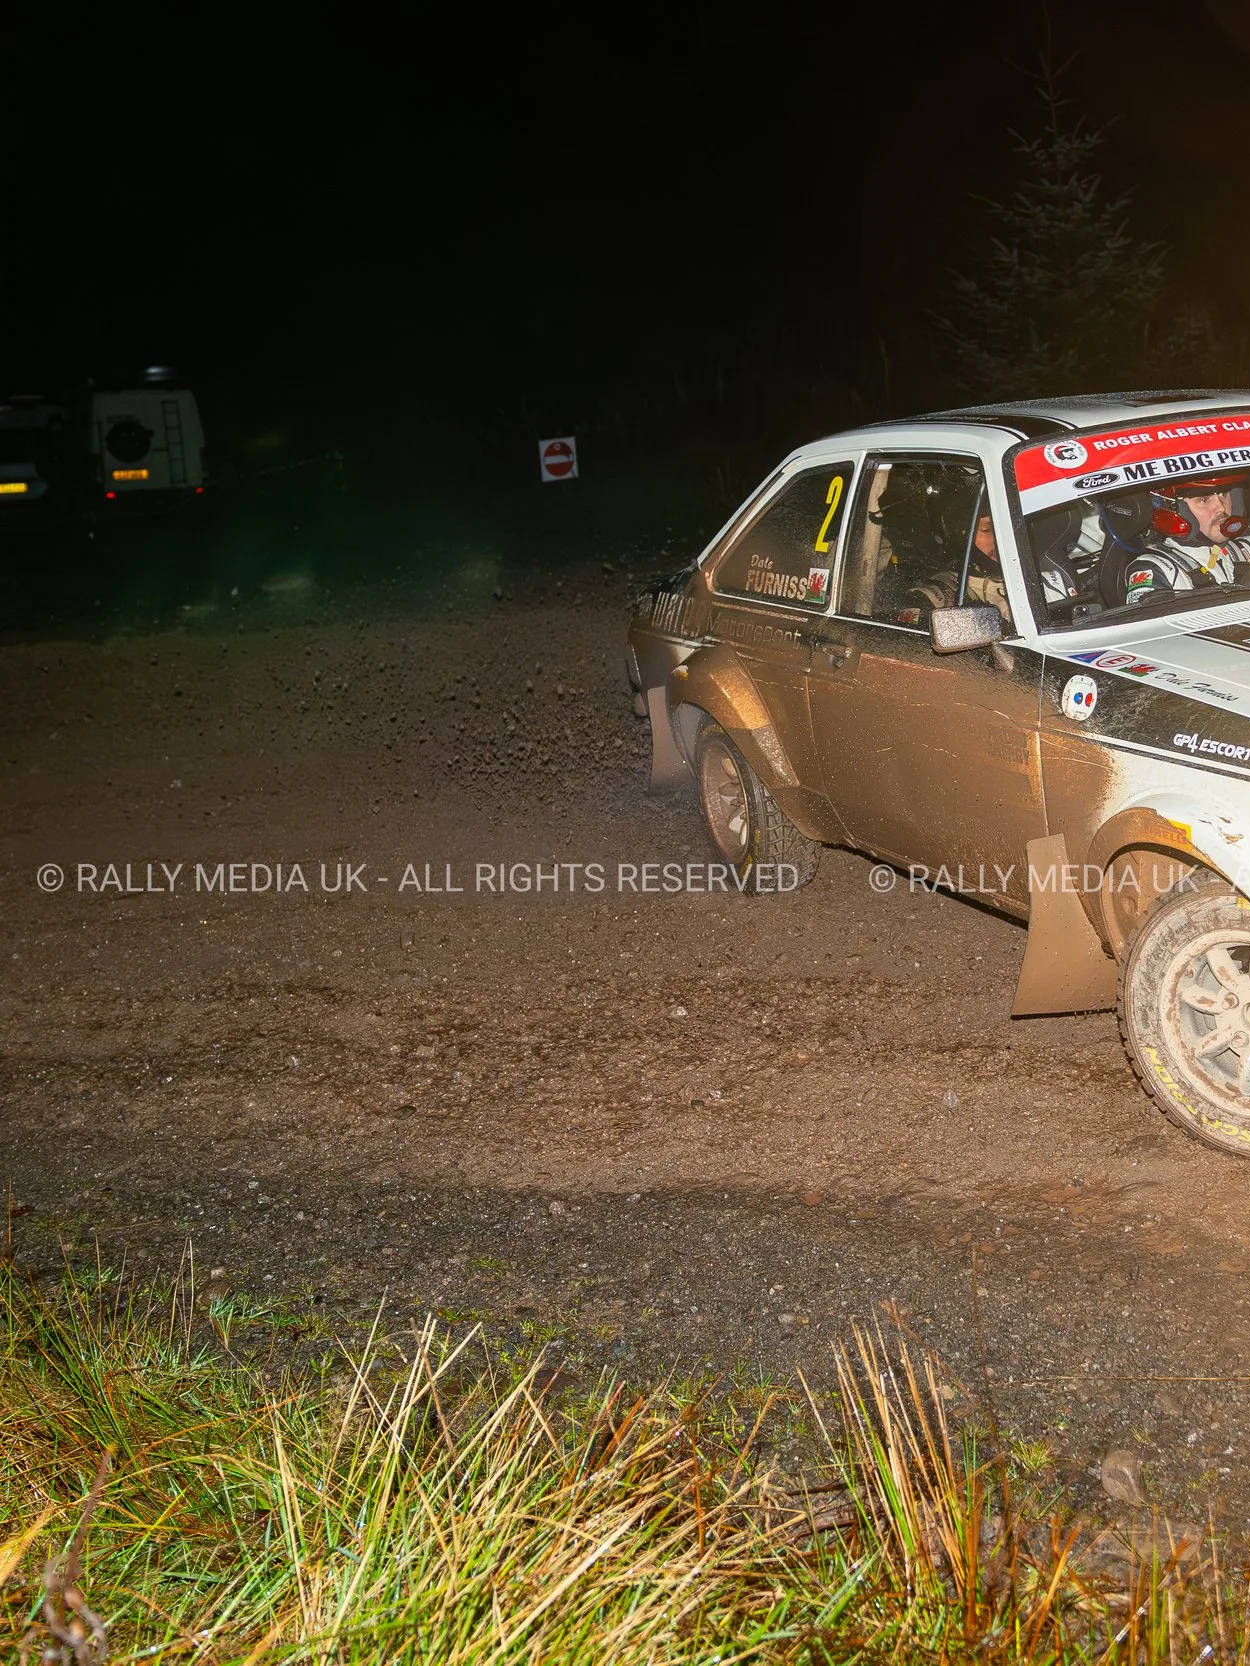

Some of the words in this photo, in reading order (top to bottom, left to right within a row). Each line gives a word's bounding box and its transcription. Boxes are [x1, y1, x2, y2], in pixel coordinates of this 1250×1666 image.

[1093, 432, 1153, 450] ROGER
[1157, 423, 1218, 440] ALBERT
[1123, 464, 1161, 482] ME
[1163, 452, 1214, 475] BDG
[1082, 475, 1111, 488] Ford
[815, 476, 843, 553] 2
[751, 554, 774, 570] Dale
[745, 569, 808, 601] FURNISS
[1173, 733, 1200, 753] GP4
